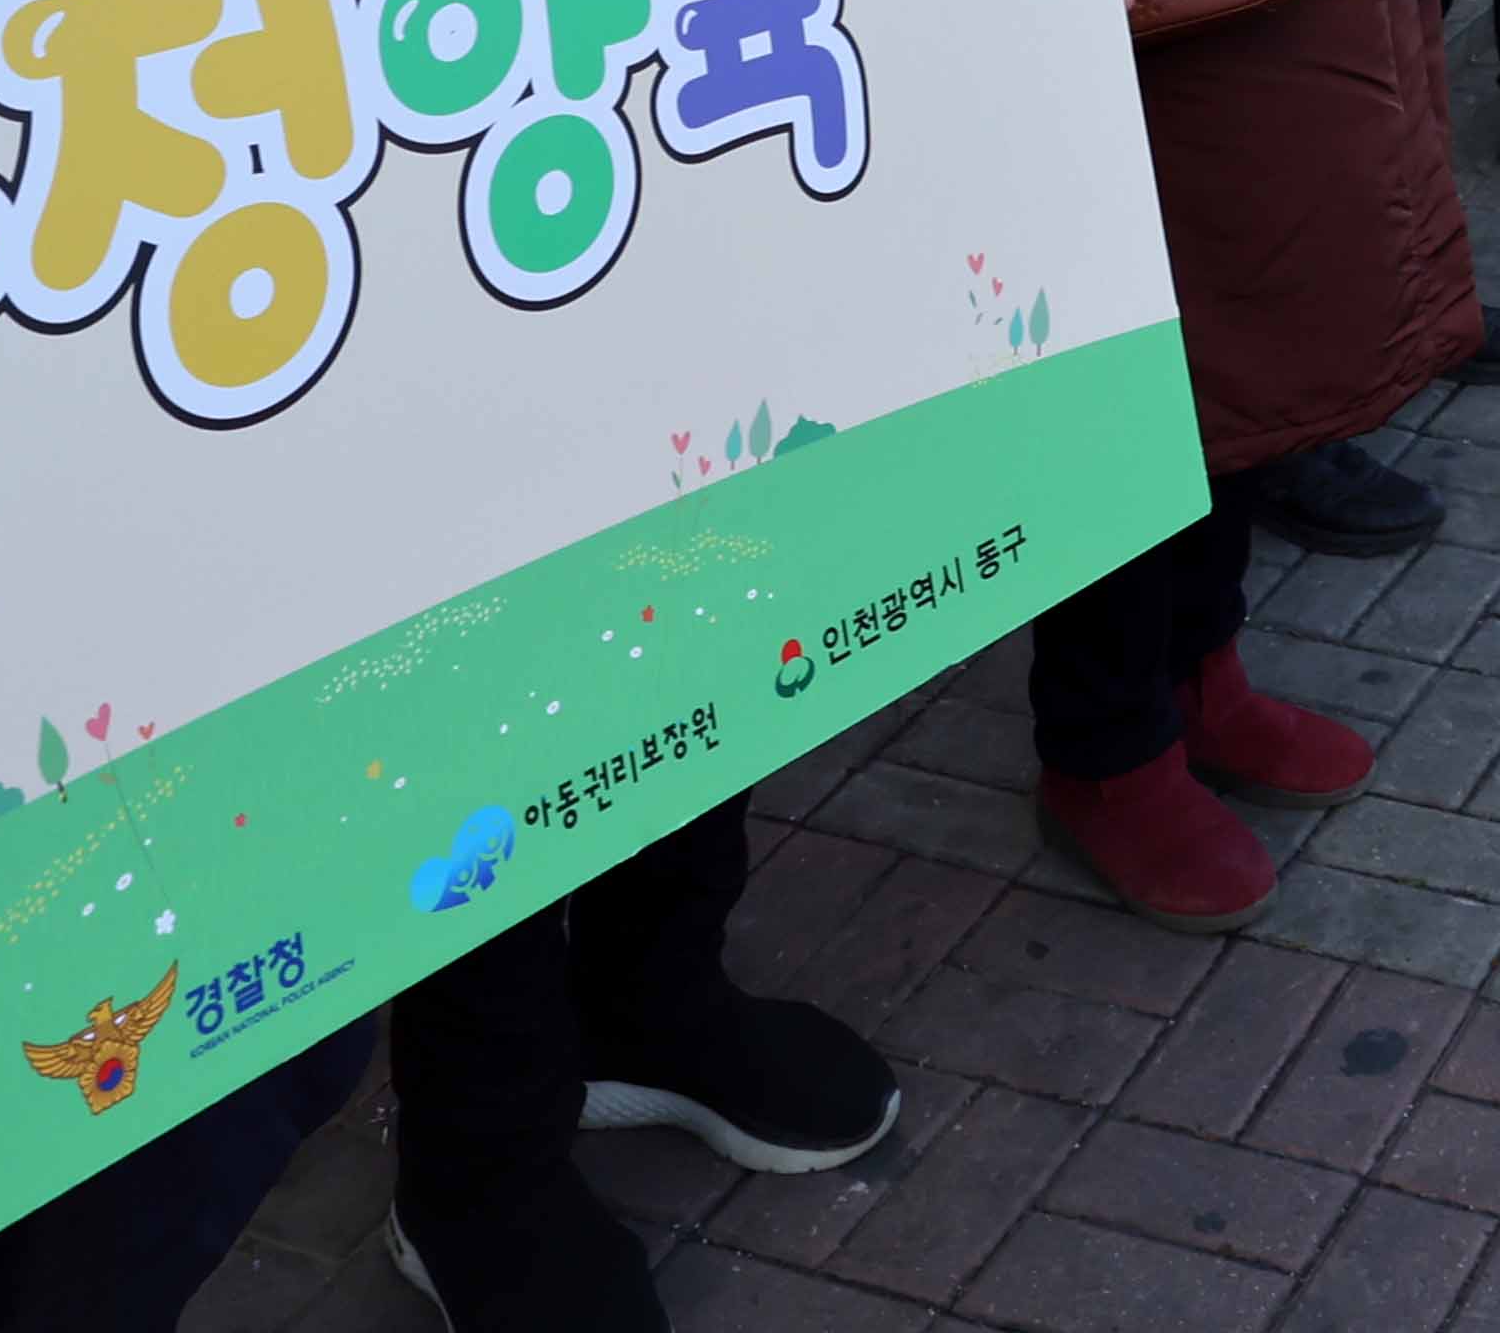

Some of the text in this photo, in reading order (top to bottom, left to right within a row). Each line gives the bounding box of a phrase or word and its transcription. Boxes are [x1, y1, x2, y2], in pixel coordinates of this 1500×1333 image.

[821, 524, 1028, 666] 인천광역시 동구
[524, 702, 721, 831] 아동권리보장원
[185, 931, 305, 1035] 경찰청
[189, 1030, 231, 1059] KOREAN
[231, 1002, 280, 1035] NATIONAL
[280, 980, 316, 1008] POLICE
